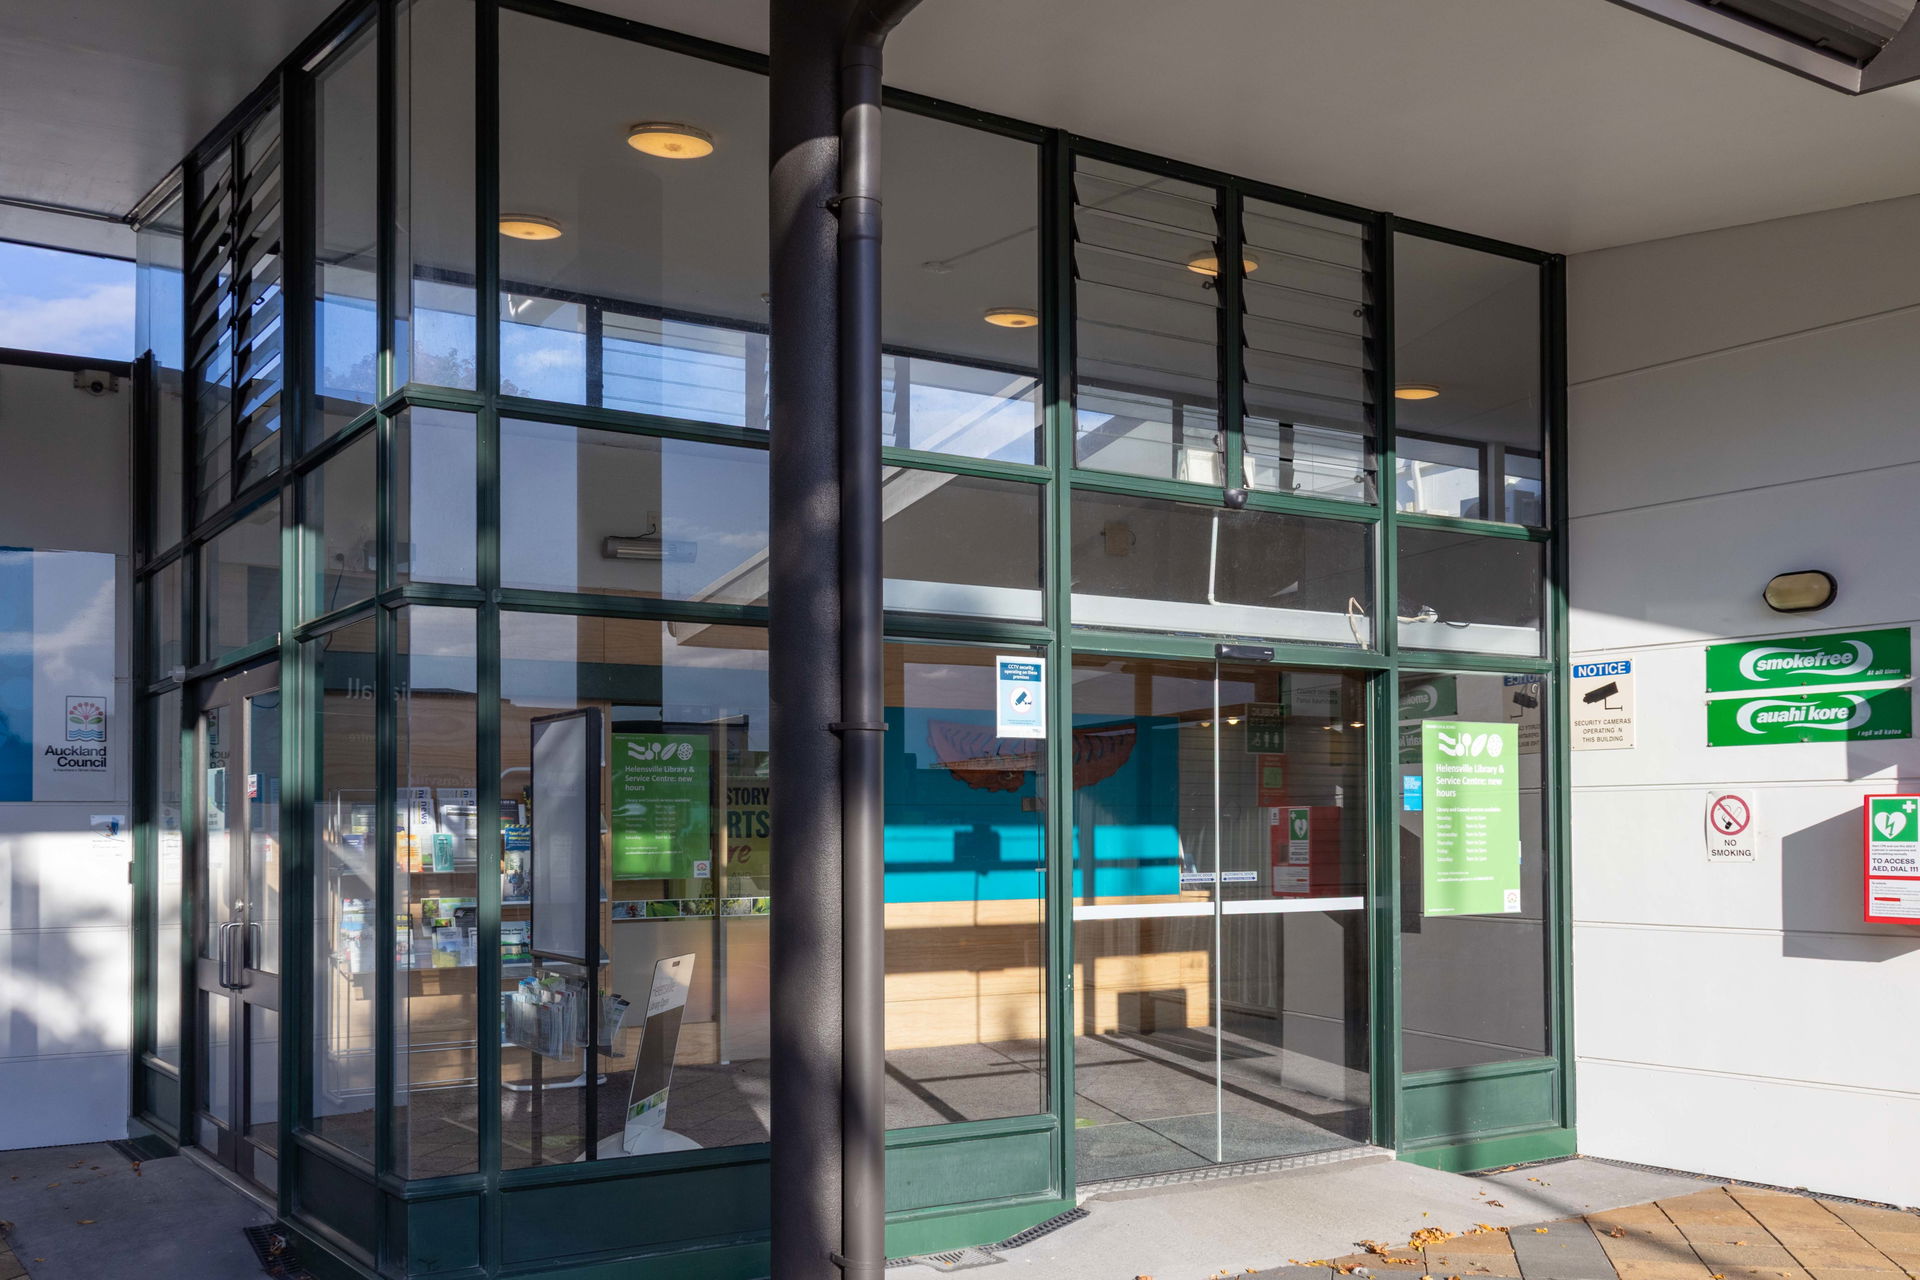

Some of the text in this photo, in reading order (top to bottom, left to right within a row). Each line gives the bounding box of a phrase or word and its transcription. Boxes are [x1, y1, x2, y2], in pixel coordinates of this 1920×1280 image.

[1756, 652, 1853, 672] smokefree
[1578, 662, 1626, 677] NOTICE
[1757, 705, 1849, 723] auahi kore
[45, 745, 106, 757] Auckland
[57, 756, 106, 768] Council
[664, 766, 688, 774] Library
[1436, 763, 1473, 773] Helensville
[1474, 764, 1497, 775] Library
[1436, 776, 1460, 785] Service
[1436, 788, 1456, 798] hours
[1711, 849, 1752, 857] SMOKING
